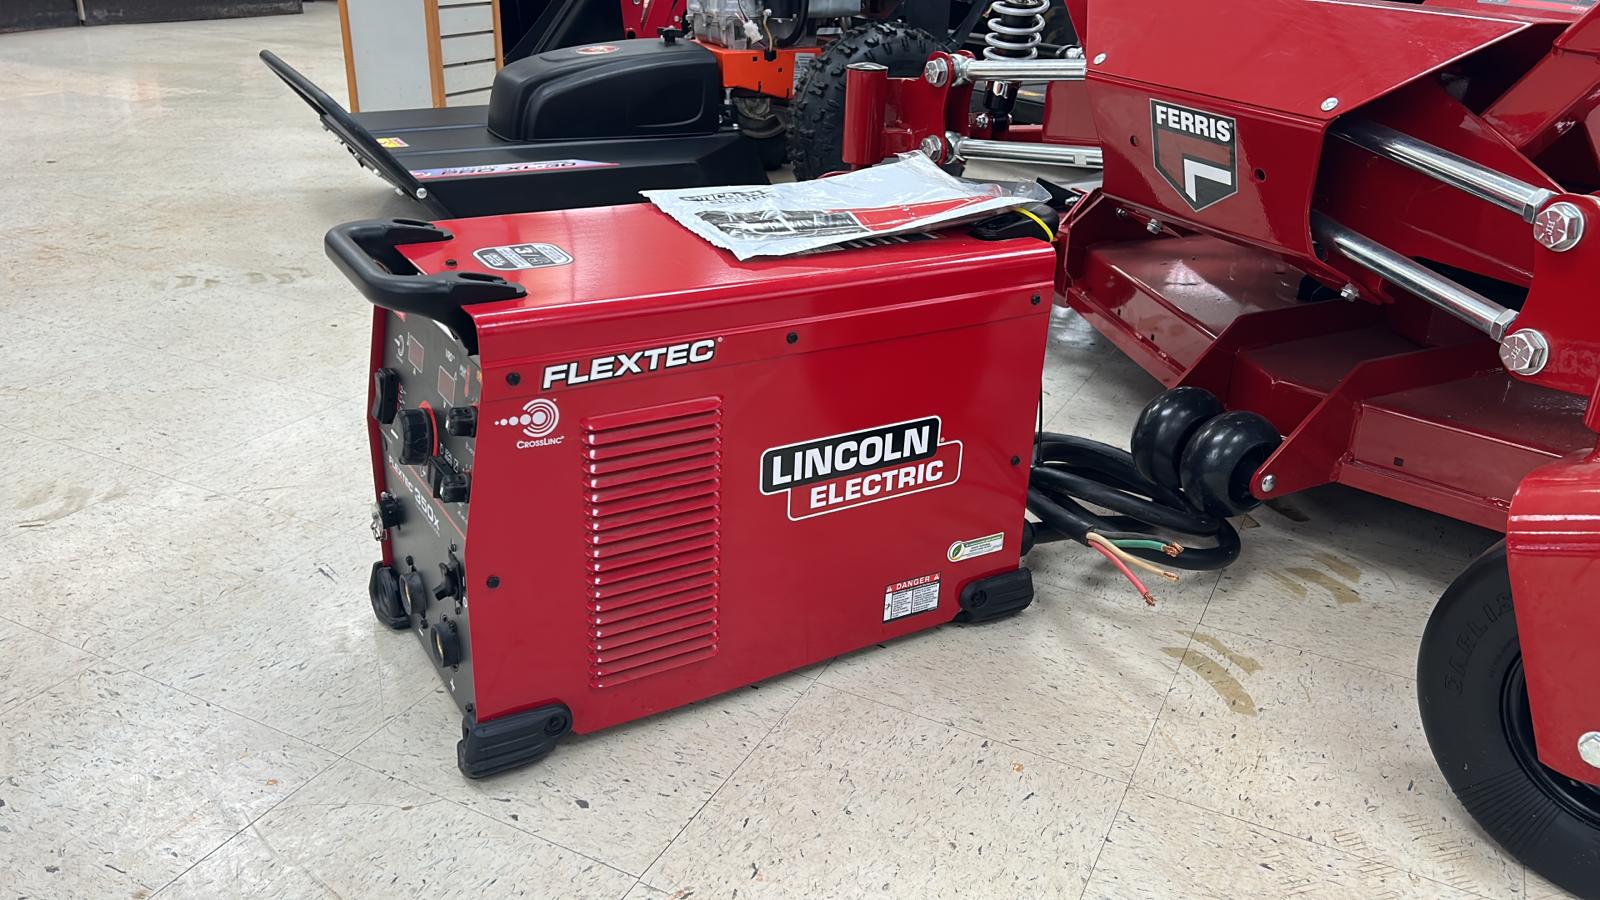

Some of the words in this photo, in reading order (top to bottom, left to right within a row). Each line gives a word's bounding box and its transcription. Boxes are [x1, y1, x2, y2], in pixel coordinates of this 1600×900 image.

[1155, 104, 1231, 142] FERRIS
[541, 338, 717, 391] FLEXTEC
[388, 455, 414, 493] FLEXTEC
[772, 425, 931, 486] LINCOLN
[809, 459, 944, 510] ELECTRIC
[896, 575, 931, 590] DANGER
